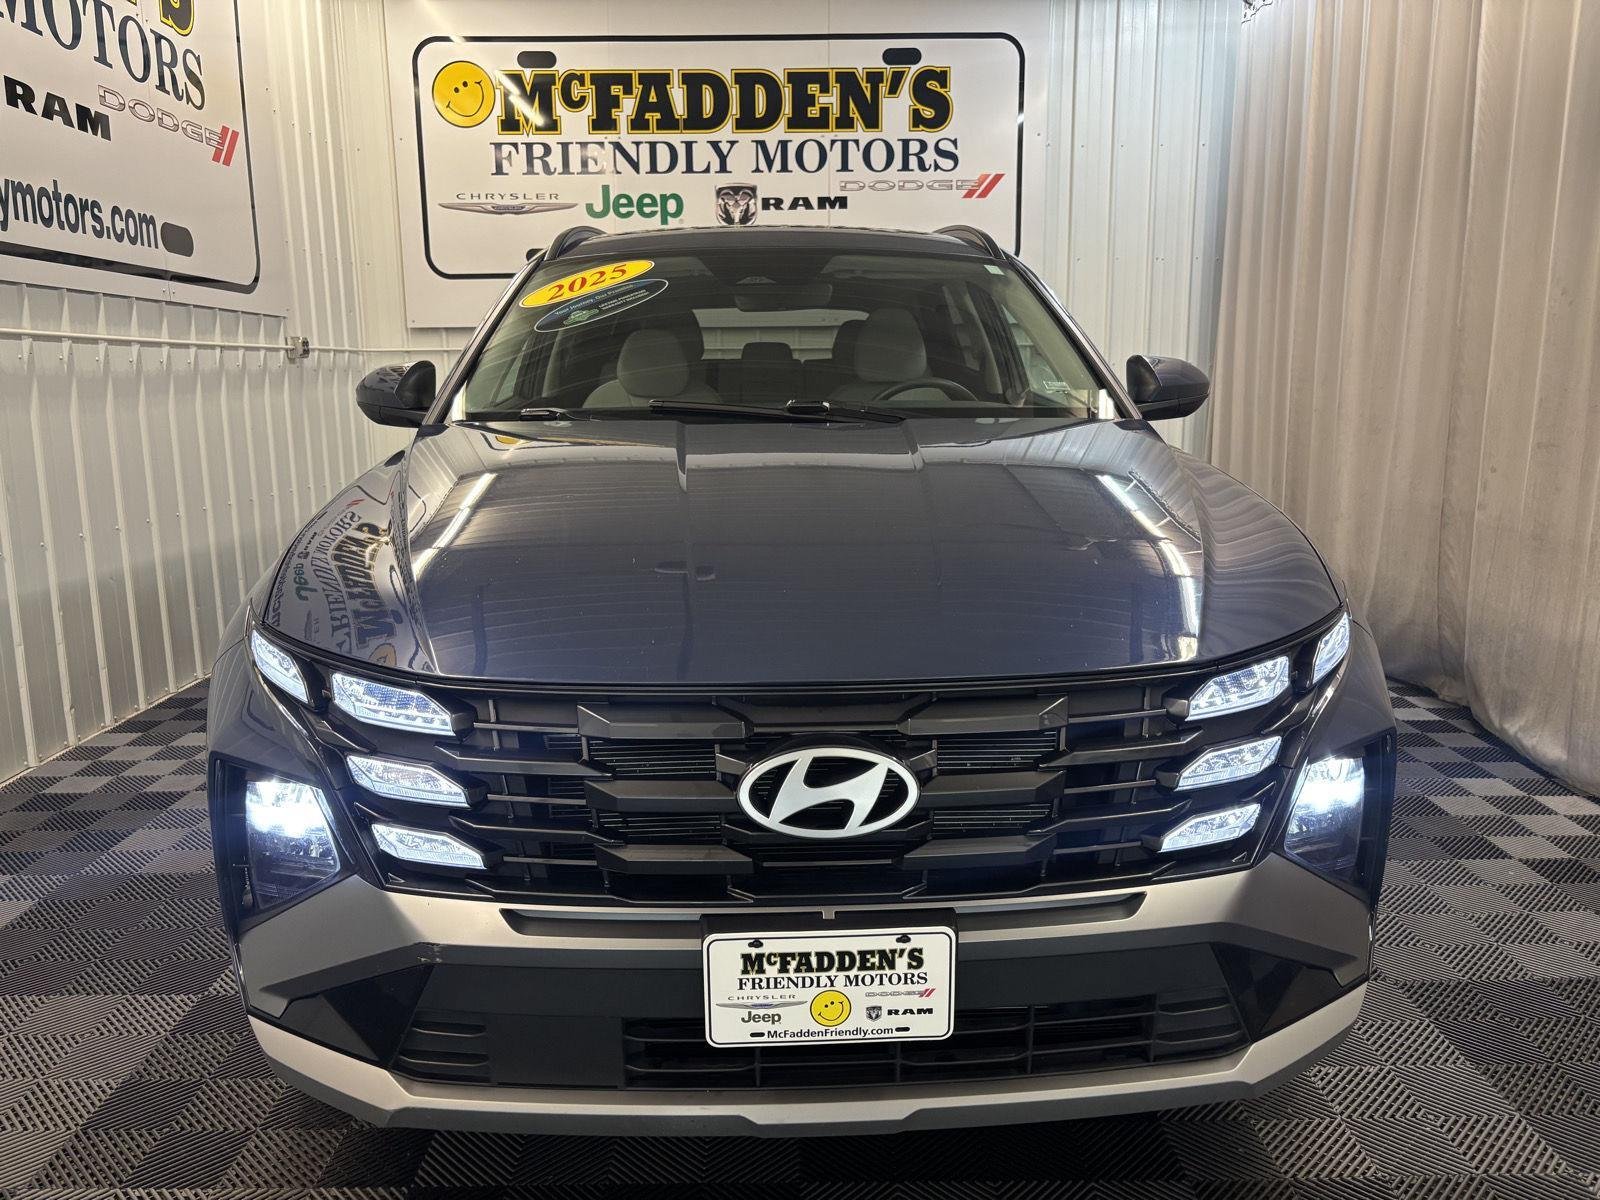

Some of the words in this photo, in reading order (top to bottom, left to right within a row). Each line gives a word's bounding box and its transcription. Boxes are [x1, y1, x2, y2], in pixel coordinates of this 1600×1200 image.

[3, 75, 112, 142] RAM
[98, 84, 227, 149] DODGE
[489, 139, 740, 176] FRIENDLY
[751, 137, 960, 174] MOTORS
[839, 179, 982, 191] DODGE
[455, 192, 560, 201] CHRYSLER
[585, 184, 684, 225] Jeep
[761, 195, 848, 211] RAM
[547, 263, 628, 302] 2025
[740, 947, 924, 975] McFADDEN'S
[737, 974, 838, 990] FRIENDLY
[843, 972, 928, 987] MOTORS
[740, 1011, 782, 1025] Jeep
[887, 1008, 934, 1016] RAM
[767, 1026, 894, 1039] McFaddenFriendly.com
